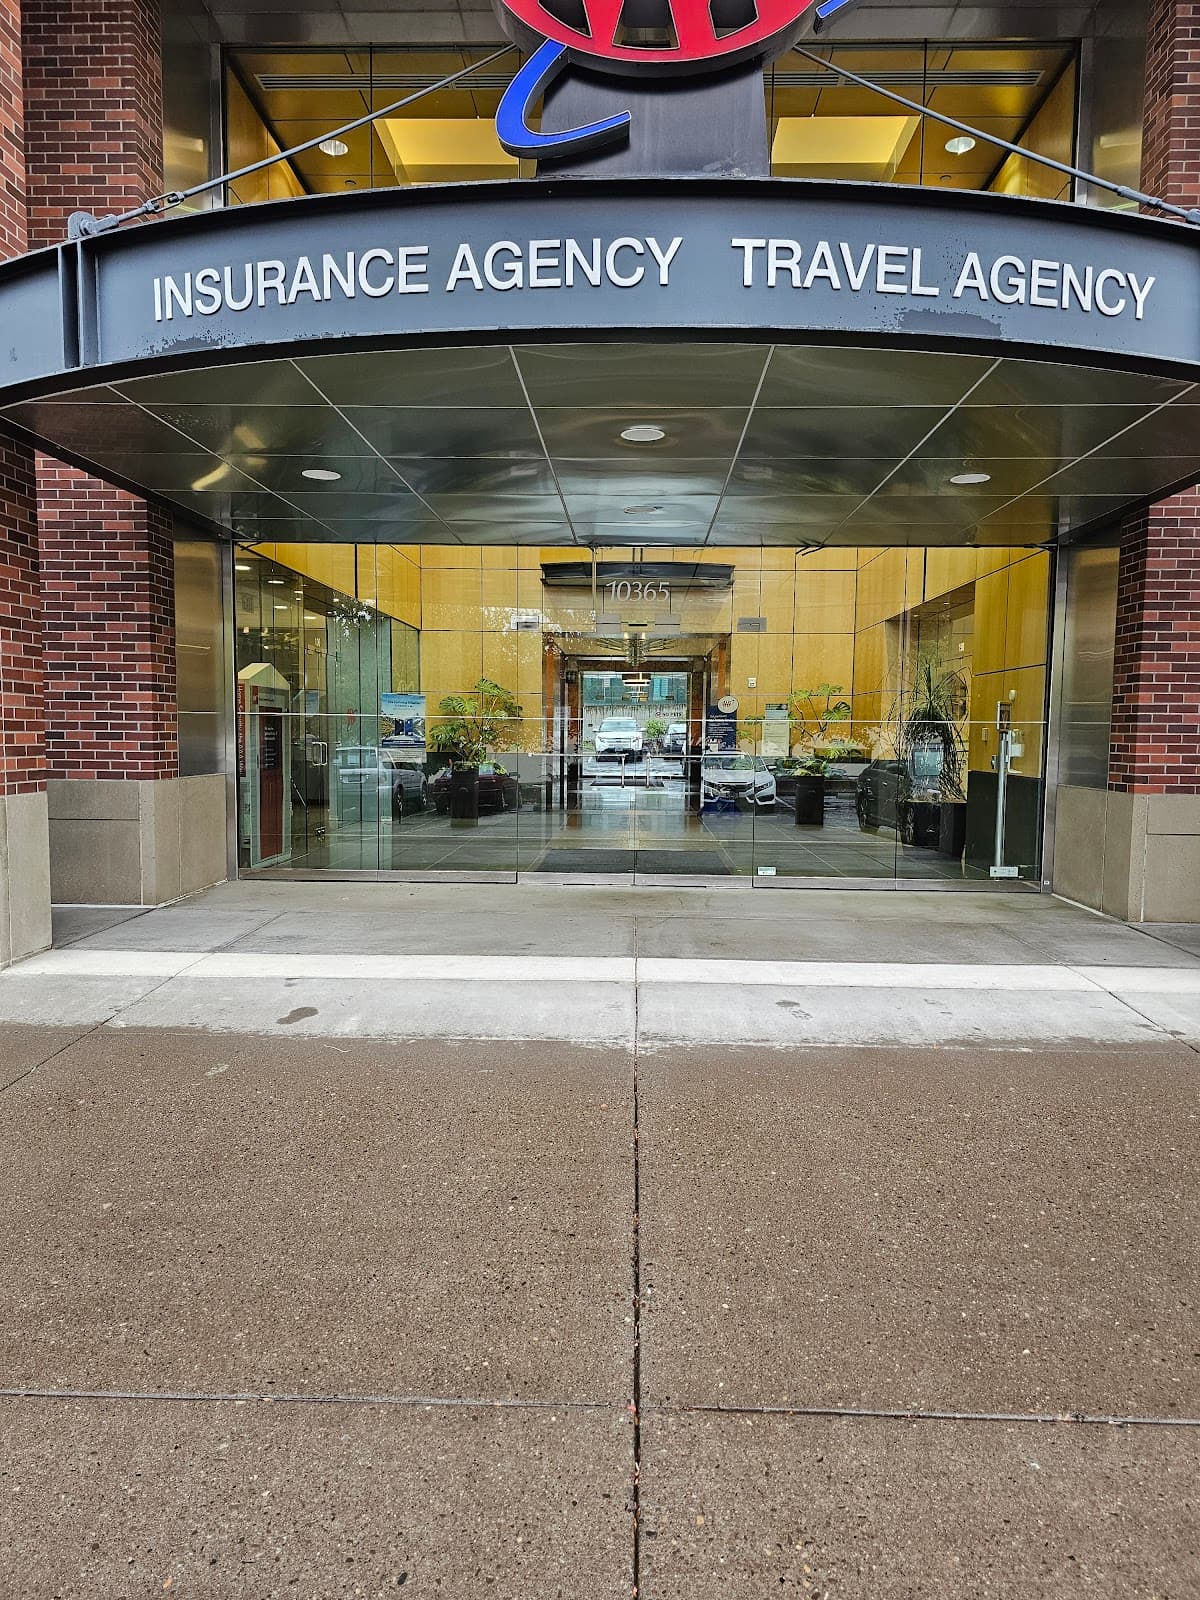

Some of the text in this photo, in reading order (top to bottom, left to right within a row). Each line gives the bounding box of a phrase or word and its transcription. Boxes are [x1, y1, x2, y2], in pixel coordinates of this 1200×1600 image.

[152, 236, 684, 322] INSURANCE AGENCY
[731, 237, 1156, 320] TRAVEL AGENCY
[606, 580, 670, 602] 10365
